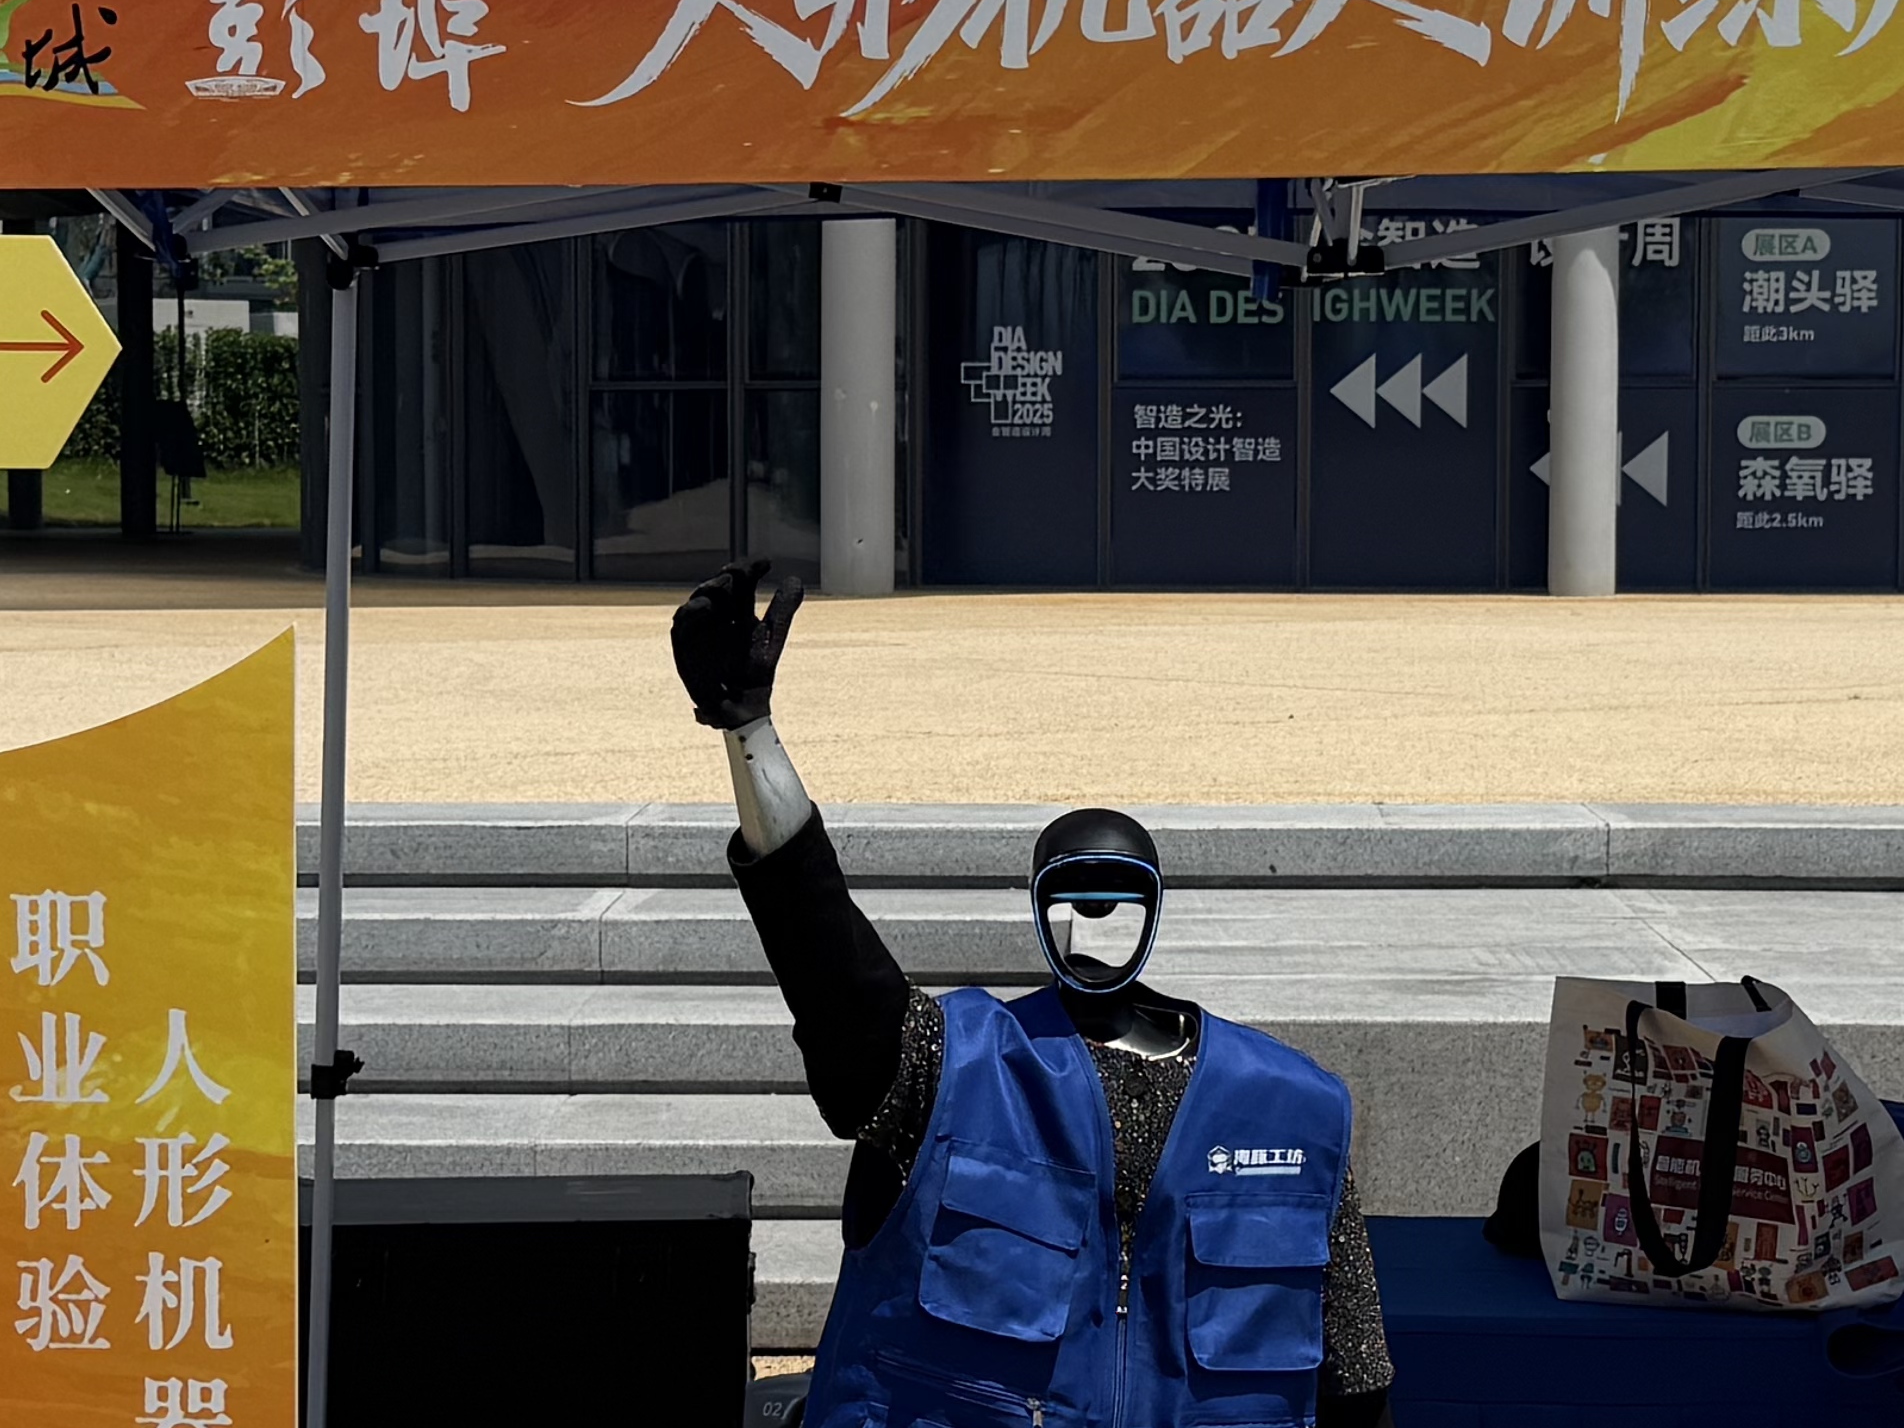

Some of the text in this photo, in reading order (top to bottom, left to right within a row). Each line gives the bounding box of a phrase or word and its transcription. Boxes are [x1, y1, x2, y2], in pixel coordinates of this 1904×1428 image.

[1752, 232, 1818, 258] 展区A
[1742, 269, 1878, 314] 潮头驿
[1131, 289, 1196, 323] DIA
[993, 325, 1027, 350] DIA
[1743, 324, 1815, 343] 距此3km
[993, 350, 1063, 376] DESIGN
[1013, 403, 1054, 425] 2025
[1133, 404, 1244, 430] 智造之光：
[1748, 420, 1813, 445] 展区B
[1131, 435, 1283, 464] 中国设计智造
[1131, 467, 1231, 492] 大奖特展
[1737, 456, 1874, 502] 森氧驿
[1736, 512, 1824, 530] 距此2.5km
[8, 888, 112, 1352] 职业体验
